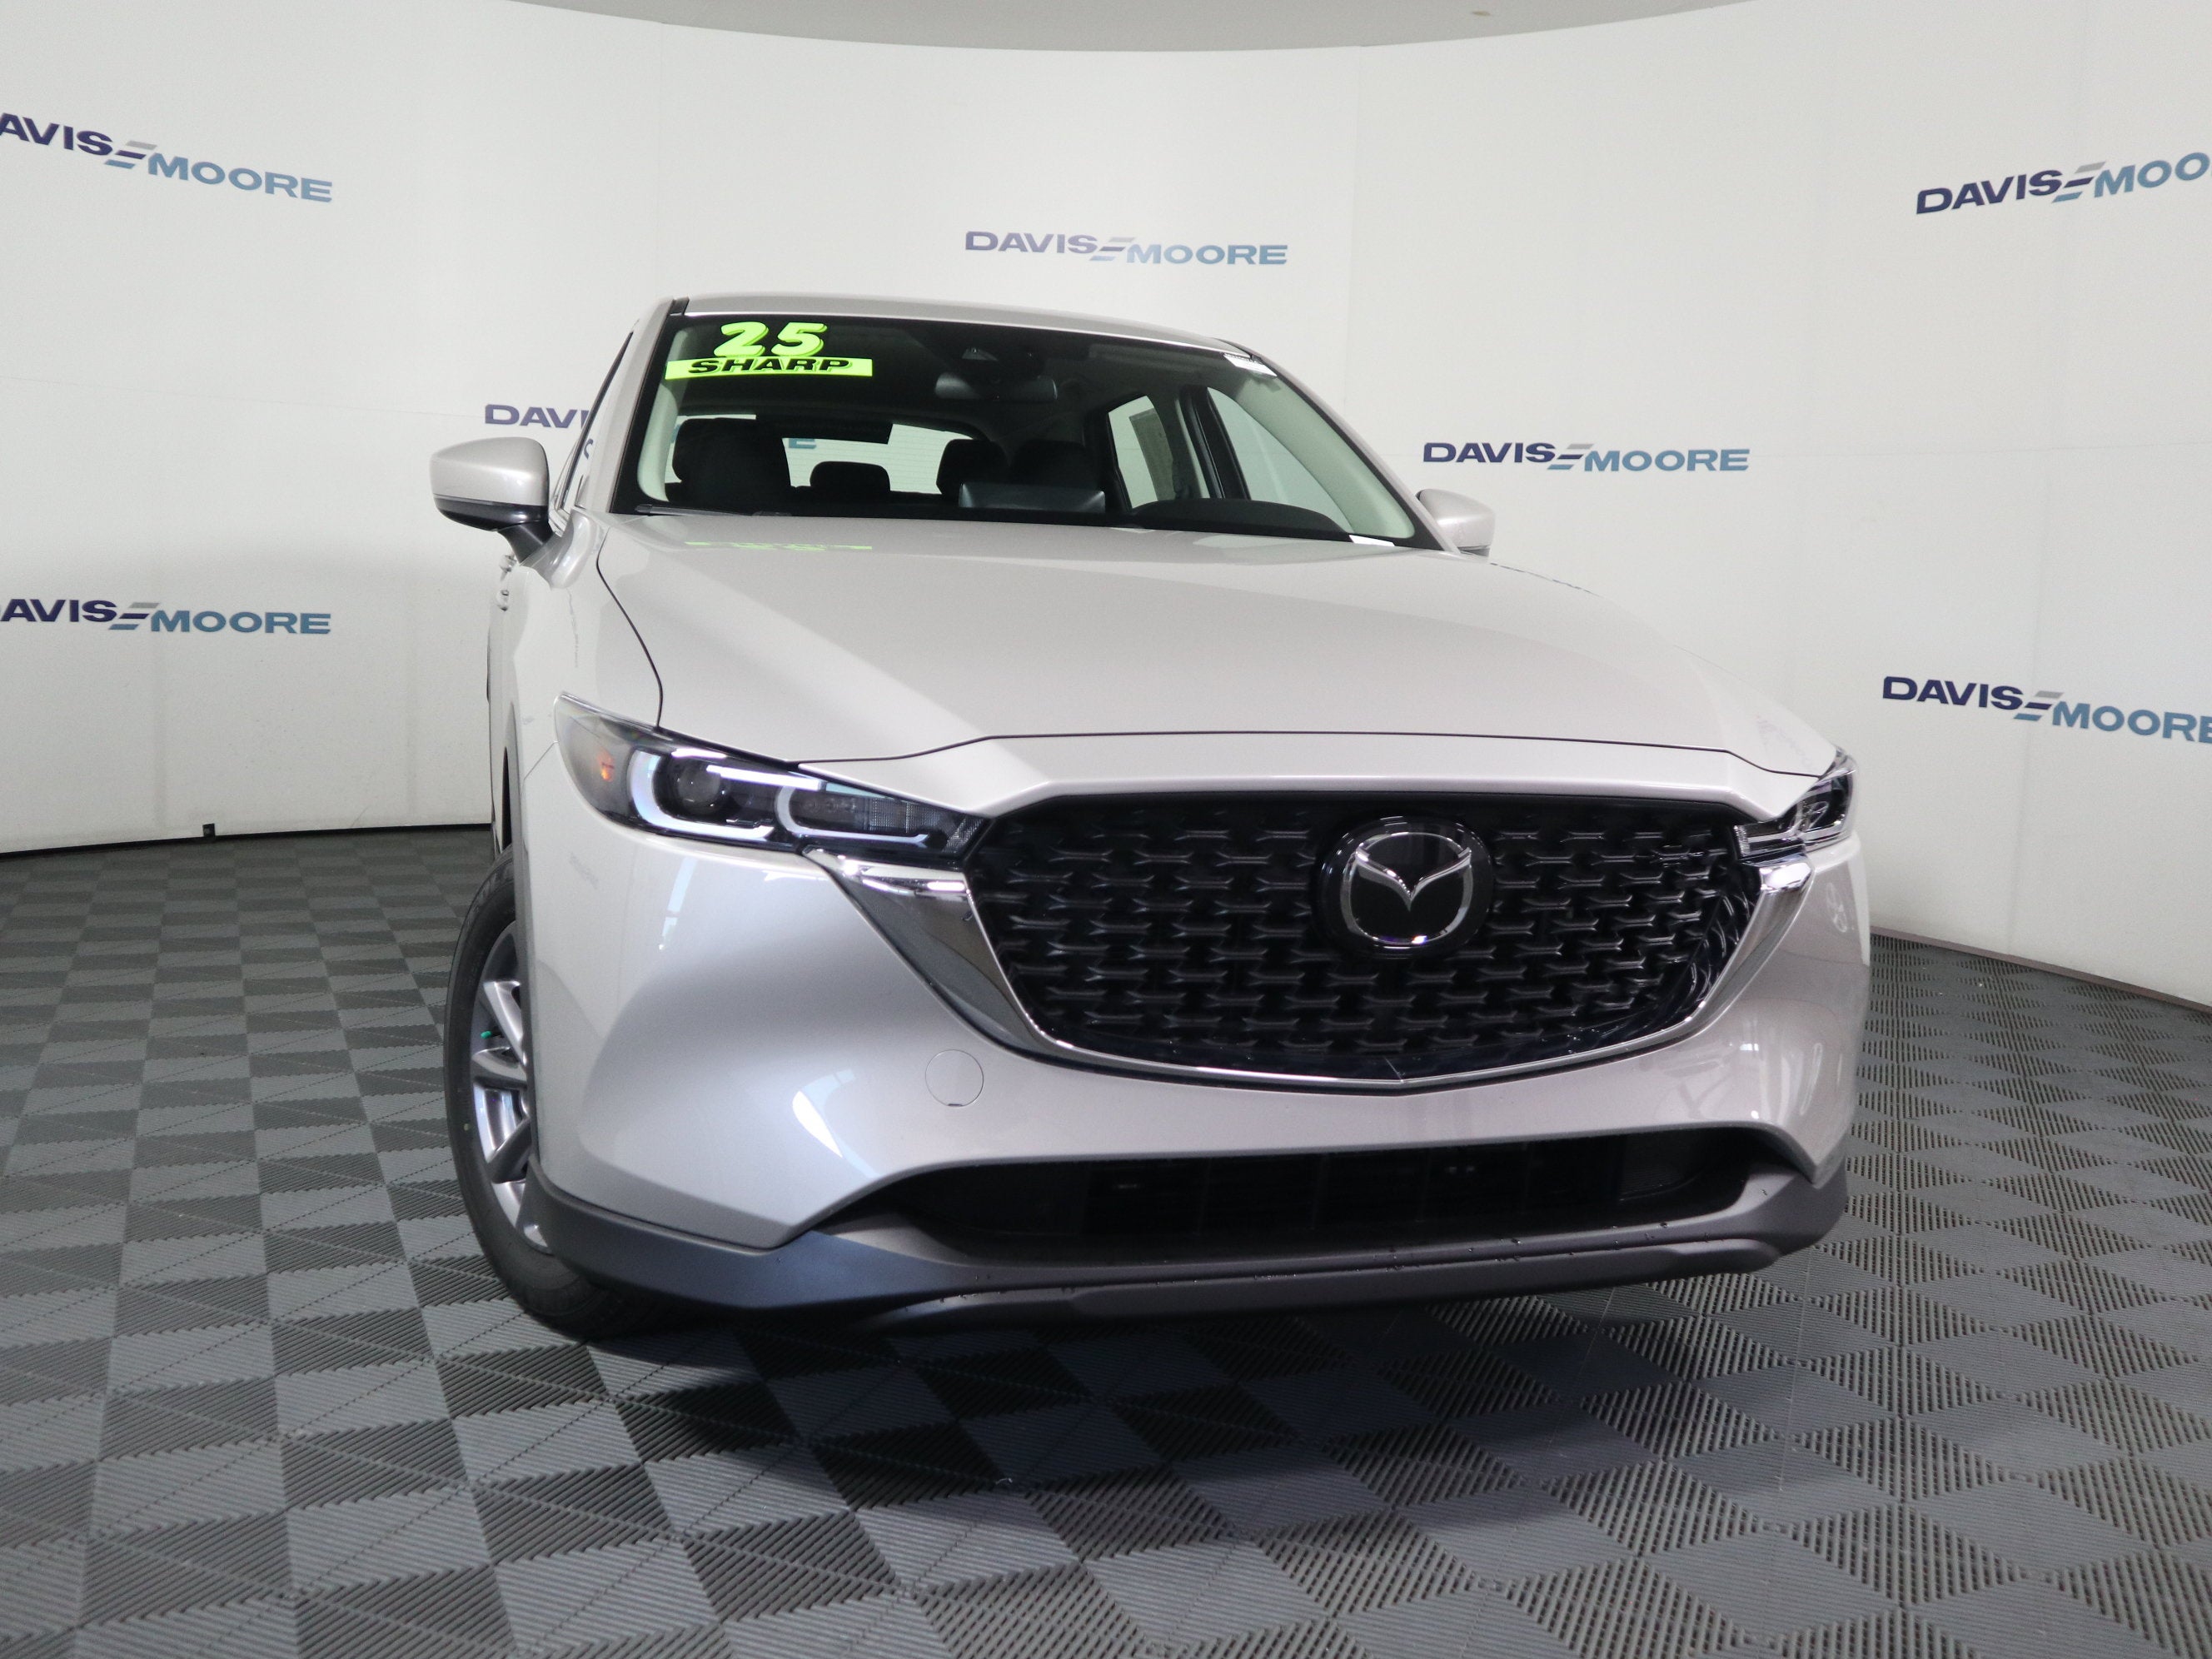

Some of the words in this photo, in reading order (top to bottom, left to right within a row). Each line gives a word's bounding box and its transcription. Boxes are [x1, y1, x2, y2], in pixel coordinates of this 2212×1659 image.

[0, 112, 113, 156] AVIS
[147, 153, 332, 202] MOORE
[1916, 169, 2063, 215] DAVIS
[2094, 152, 2212, 198] MOO
[964, 231, 1098, 254] DAVIS
[1126, 243, 1288, 265] MOORE
[713, 321, 828, 357] 25
[687, 358, 853, 374] SHARP
[485, 404, 590, 429] DAVI
[1422, 442, 1556, 464] DAVIS
[1584, 449, 1751, 472] MOORE
[0, 598, 117, 622] AVIS
[151, 610, 331, 635] MOORE
[1882, 676, 2024, 710] DAVIS
